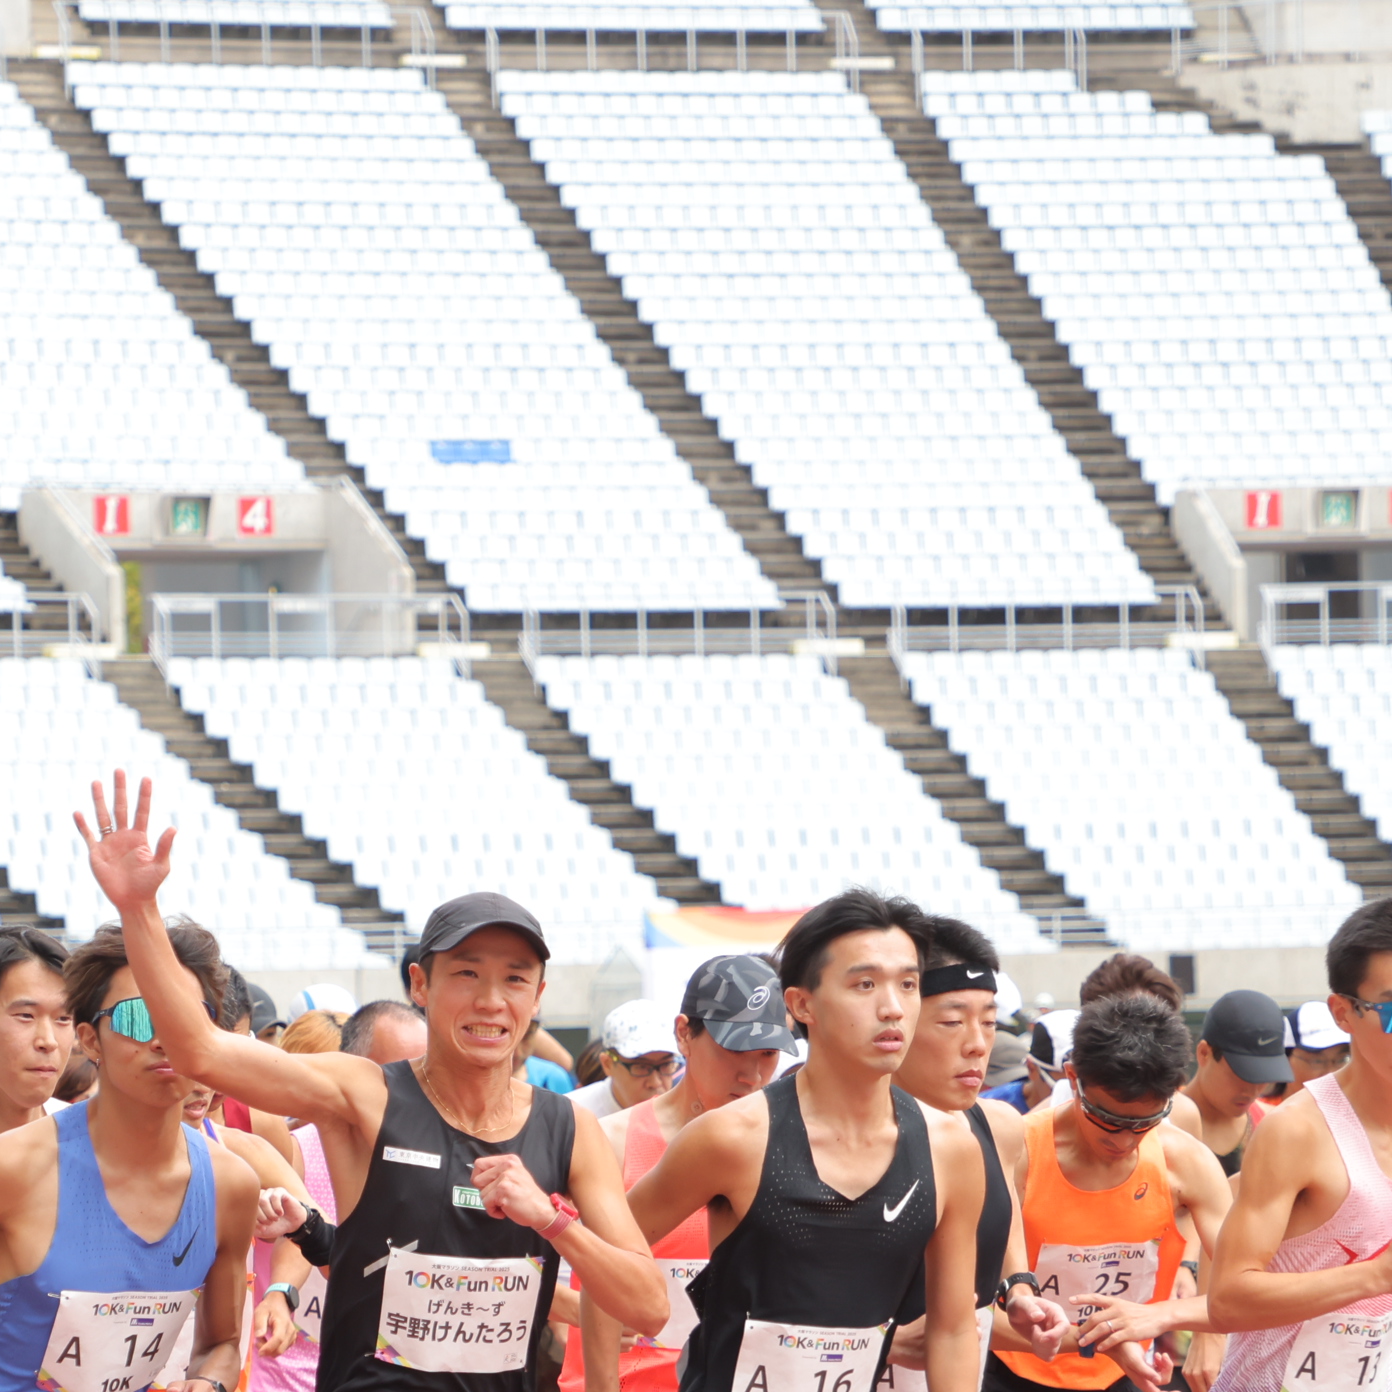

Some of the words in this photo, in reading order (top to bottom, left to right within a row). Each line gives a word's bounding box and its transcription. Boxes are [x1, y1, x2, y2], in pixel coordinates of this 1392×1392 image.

[242, 497, 269, 533] 4
[491, 1275, 530, 1293] RUN
[1040, 1275, 1060, 1296] A
[1094, 1272, 1132, 1296] 25
[153, 1301, 182, 1315] RUN
[304, 1296, 321, 1319] A
[386, 1312, 528, 1343] 宇野けんたろう
[56, 1336, 81, 1367] A
[124, 1332, 164, 1367] 14
[842, 1338, 870, 1350] RUN
[1295, 1351, 1316, 1381] A
[101, 1376, 133, 1392] 10K
